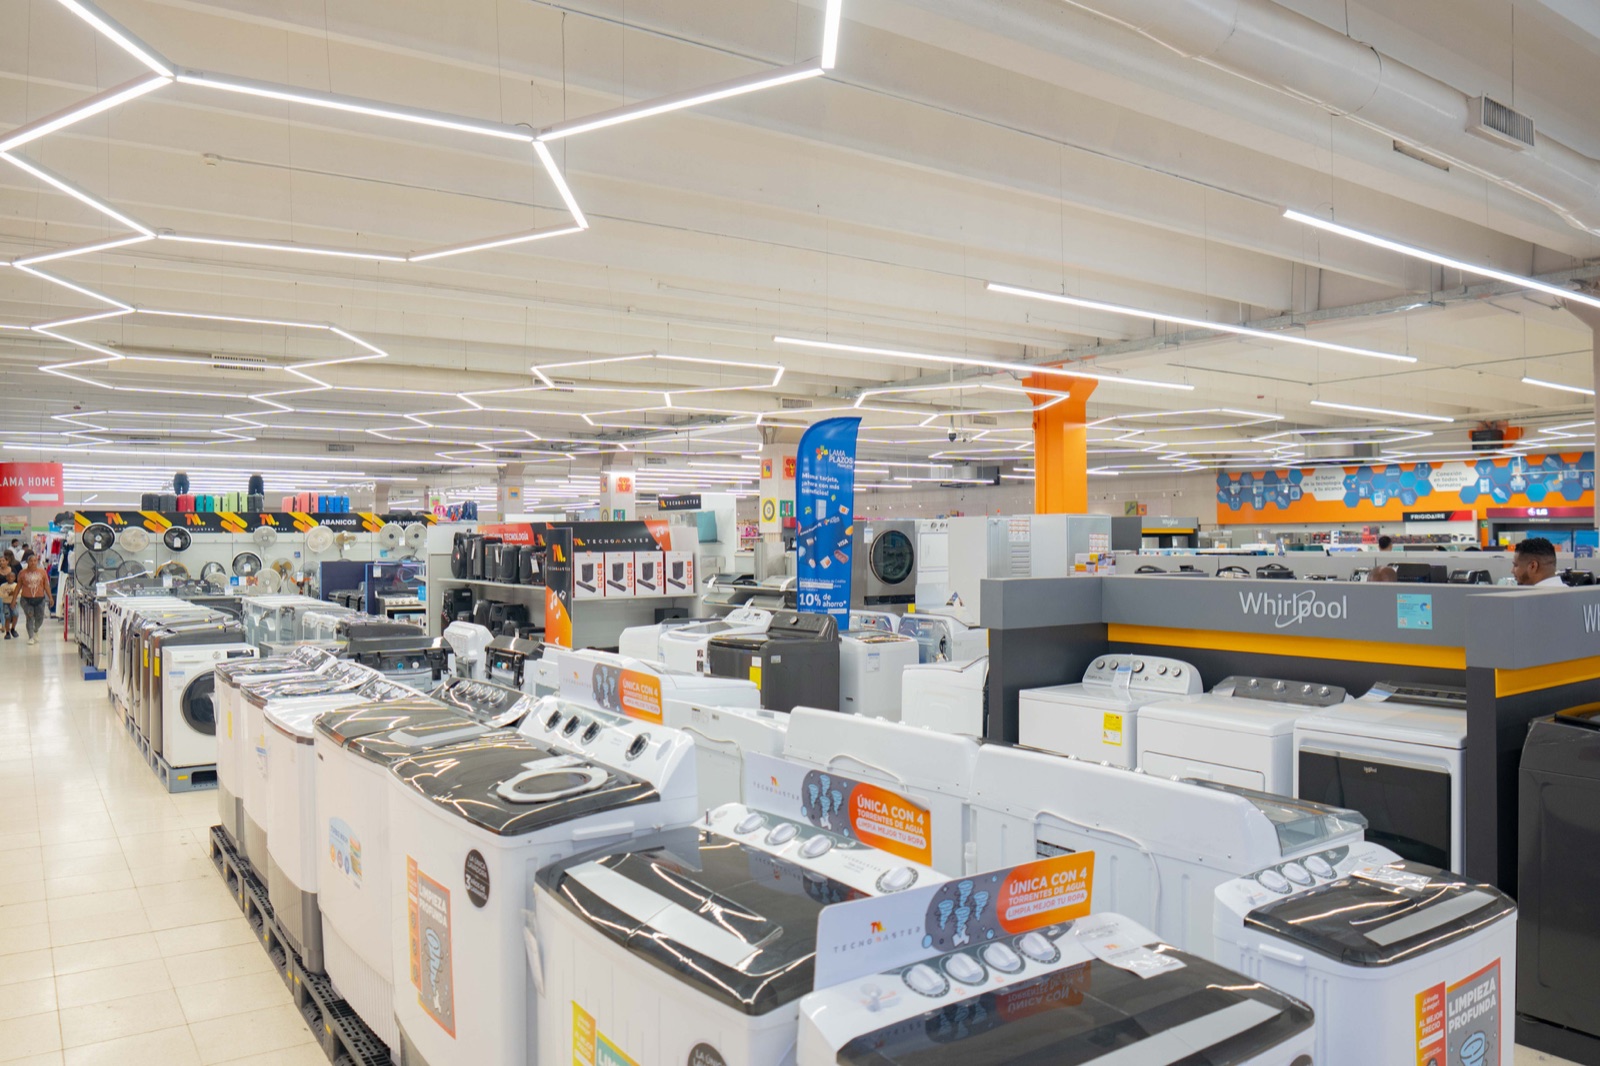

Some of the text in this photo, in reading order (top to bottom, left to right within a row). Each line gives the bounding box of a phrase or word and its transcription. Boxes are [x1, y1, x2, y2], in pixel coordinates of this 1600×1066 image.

[829, 455, 853, 464] PLAZOS
[0, 476, 55, 487] AMA HOME
[319, 518, 357, 526] ABANICOS
[587, 537, 650, 545] TECNOMASTER
[800, 593, 821, 607] 10%
[1238, 590, 1348, 626] Whirlpool
[857, 793, 925, 825] ÚNICA CON 4
[857, 807, 924, 836] TORRENTES DE AGUA
[877, 825, 897, 837] MEJOR
[908, 835, 924, 846] ROPA
[466, 873, 472, 890] 3
[1008, 881, 1086, 906] TORRENTES DE AGUA
[1009, 866, 1087, 896] ÚNICA CON 4
[419, 882, 448, 915] LIMPIEZA
[1008, 892, 1085, 918] LIMPIA MEJOR TU ROPA
[833, 926, 922, 953] TECNOMASTER
[1448, 976, 1496, 1017] LIMPIEZA
[1426, 1010, 1443, 1024] MEJOR
[1448, 993, 1497, 1034] PROFUNDA
[1422, 1020, 1441, 1036] PRECIO
